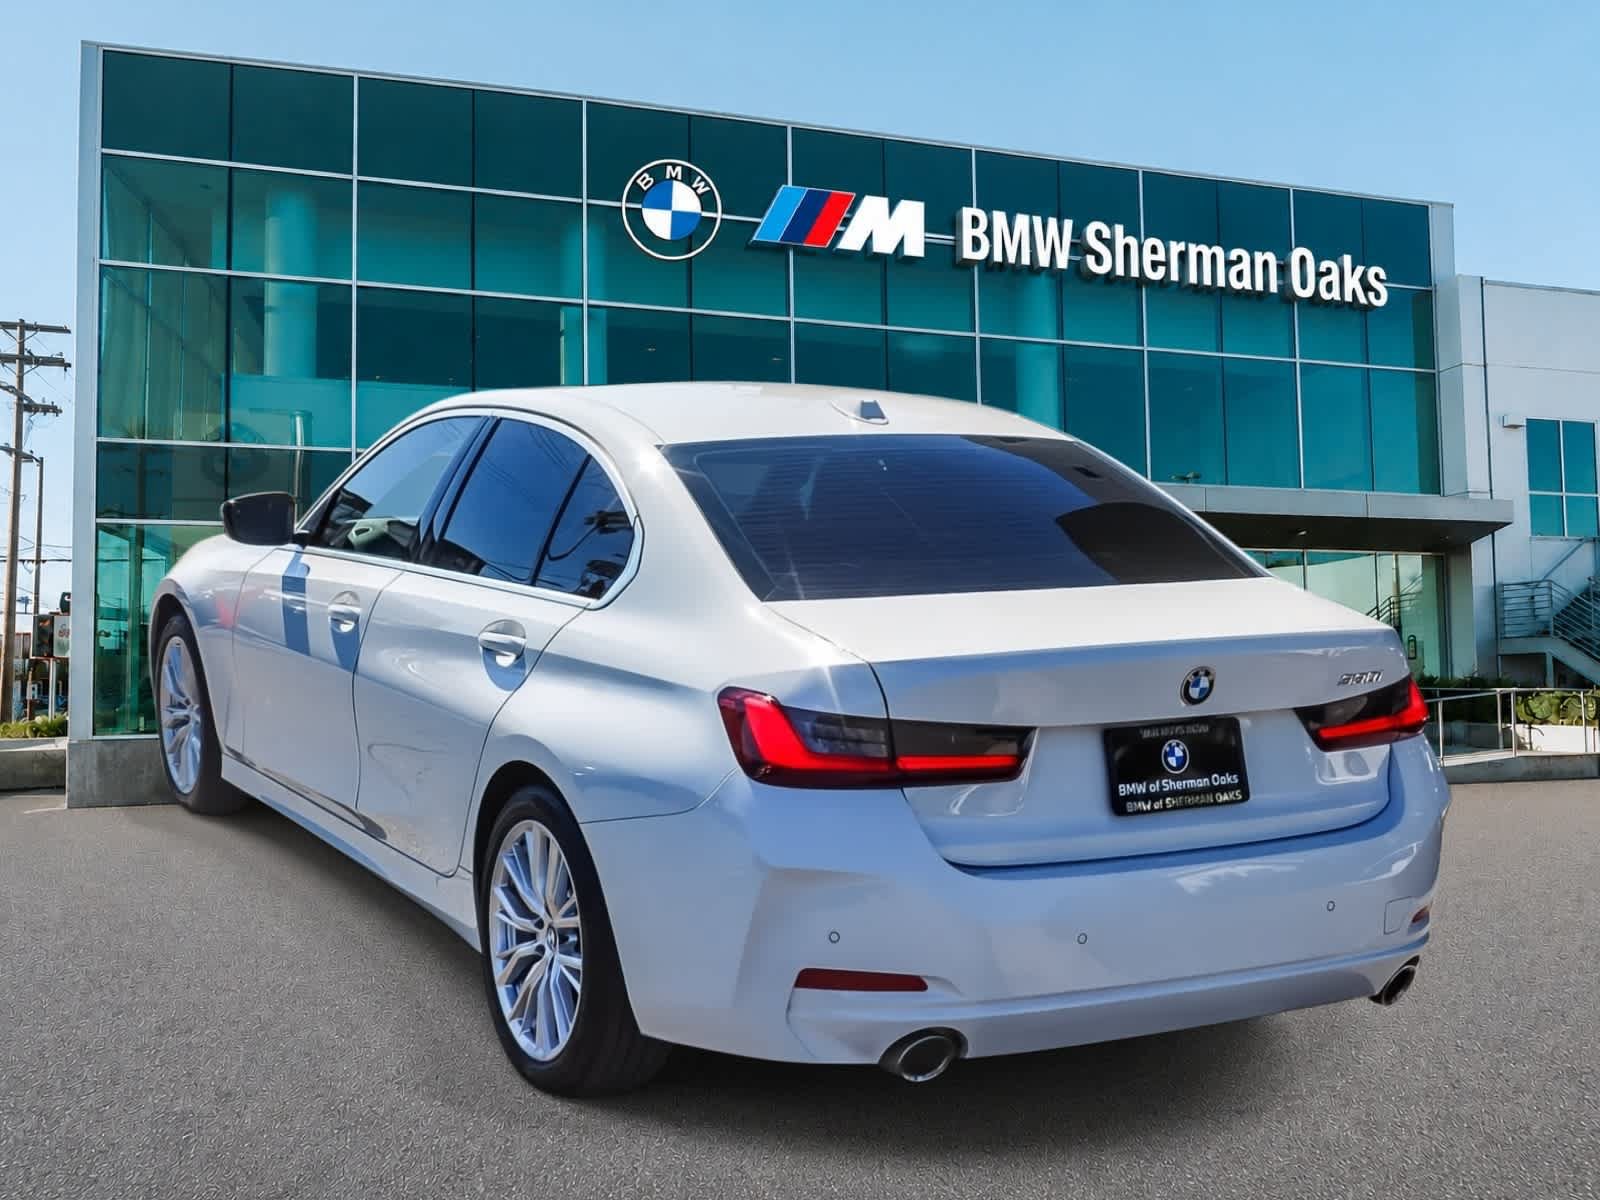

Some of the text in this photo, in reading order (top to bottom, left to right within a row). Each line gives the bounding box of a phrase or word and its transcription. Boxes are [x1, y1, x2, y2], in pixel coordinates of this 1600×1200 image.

[636, 165, 712, 196] BMW
[836, 195, 925, 258] M
[960, 206, 1389, 308] BMW Sherman Oaks
[1118, 772, 1239, 796] BMW of Sherman Oaks
[1126, 800, 1151, 812] BMW
[1153, 799, 1163, 810] of
[1215, 789, 1243, 803] OAKS
